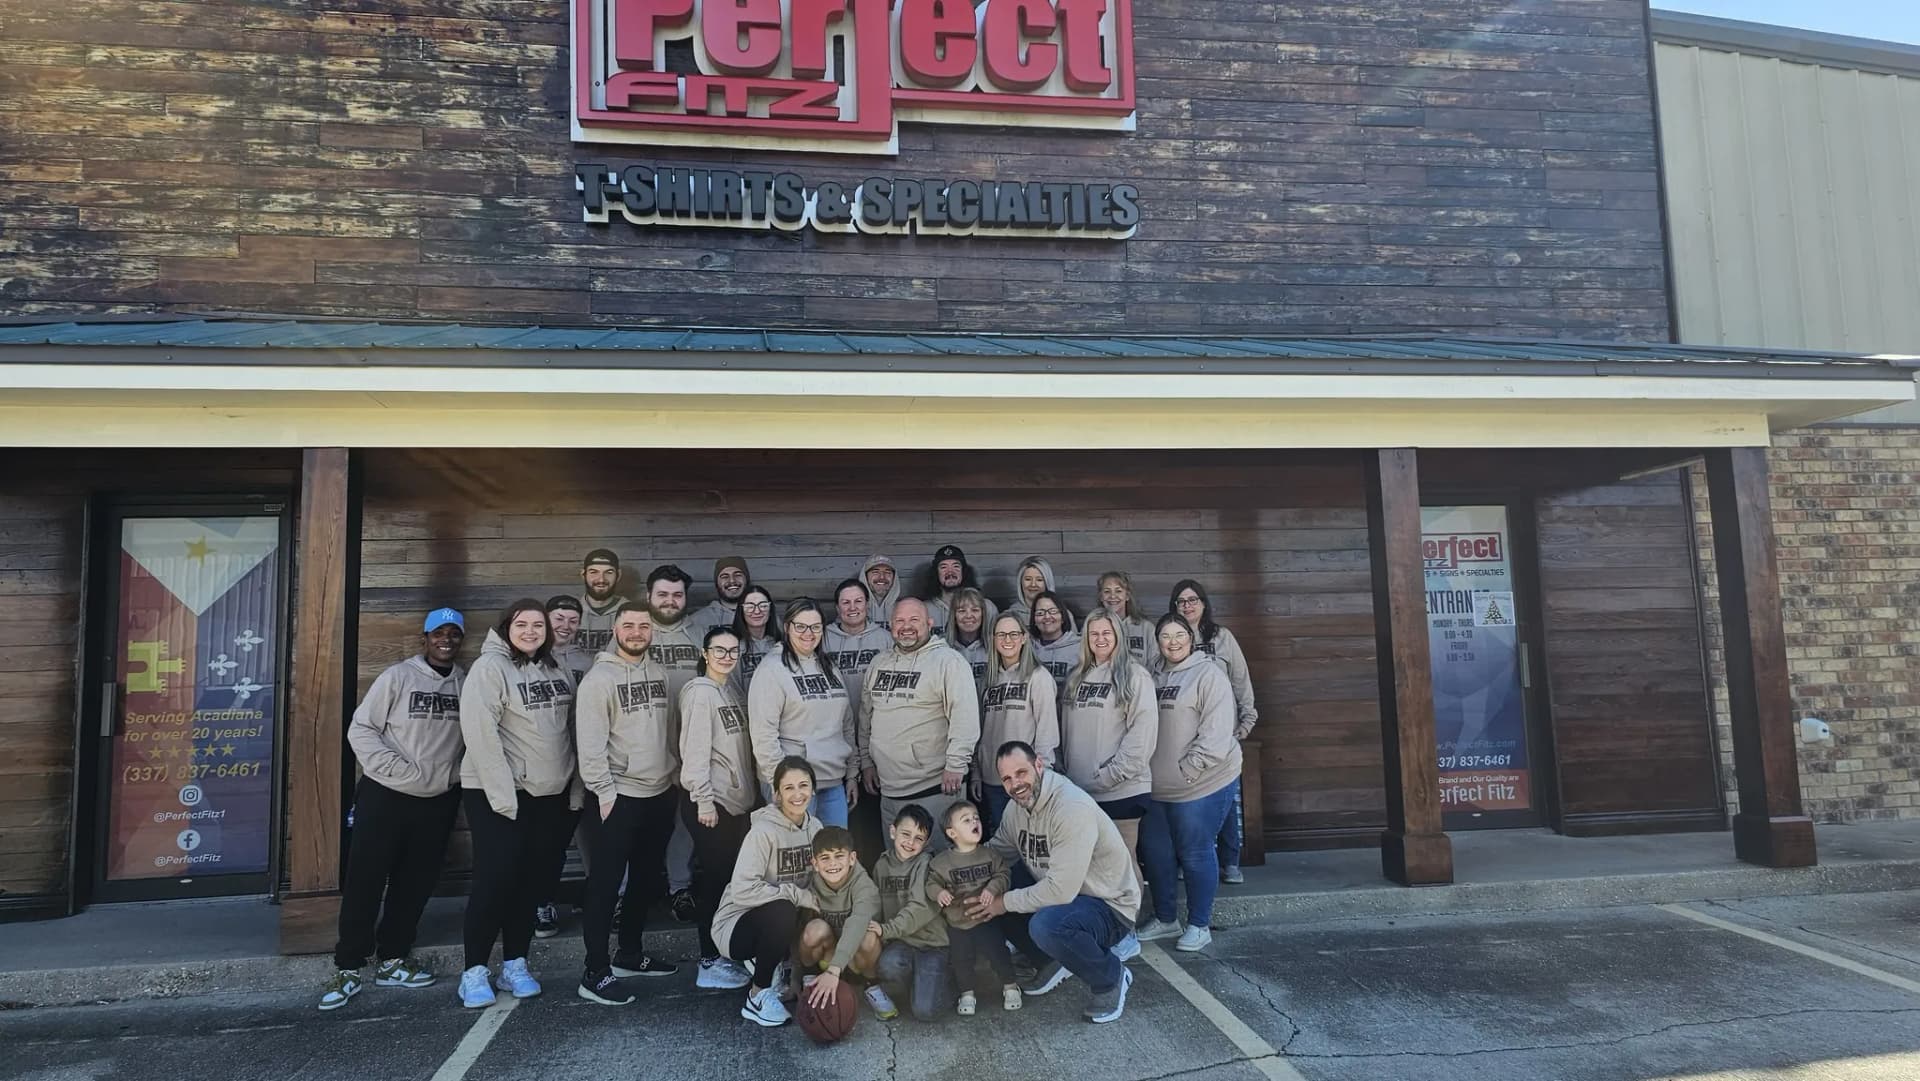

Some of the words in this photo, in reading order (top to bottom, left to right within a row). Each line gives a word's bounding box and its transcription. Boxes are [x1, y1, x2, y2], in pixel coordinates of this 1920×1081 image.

[614, 0, 1113, 139] Perfect
[606, 72, 840, 121] FITZ
[575, 164, 806, 223] T-SHIRTS
[815, 181, 852, 225] &
[861, 176, 1141, 231] SPECIALTIES
[1423, 536, 1498, 569] erfect
[1465, 569, 1505, 577] SPECIALTIES
[125, 711, 186, 726] Serving
[191, 708, 264, 722] Acadiana
[124, 730, 149, 742] for
[151, 730, 188, 741] over
[192, 727, 210, 739] 20
[214, 725, 264, 741] years!
[1438, 755, 1456, 768] 37)
[1459, 754, 1511, 767] 837-6461
[123, 765, 169, 784] (337)
[176, 762, 260, 779] 837-6461
[1486, 775, 1507, 783] Quality
[1440, 785, 1483, 805] erfect
[1488, 783, 1515, 801] Fitz
[153, 809, 226, 823] @PerfectFitz1
[154, 853, 222, 867] @PerfectFitz
